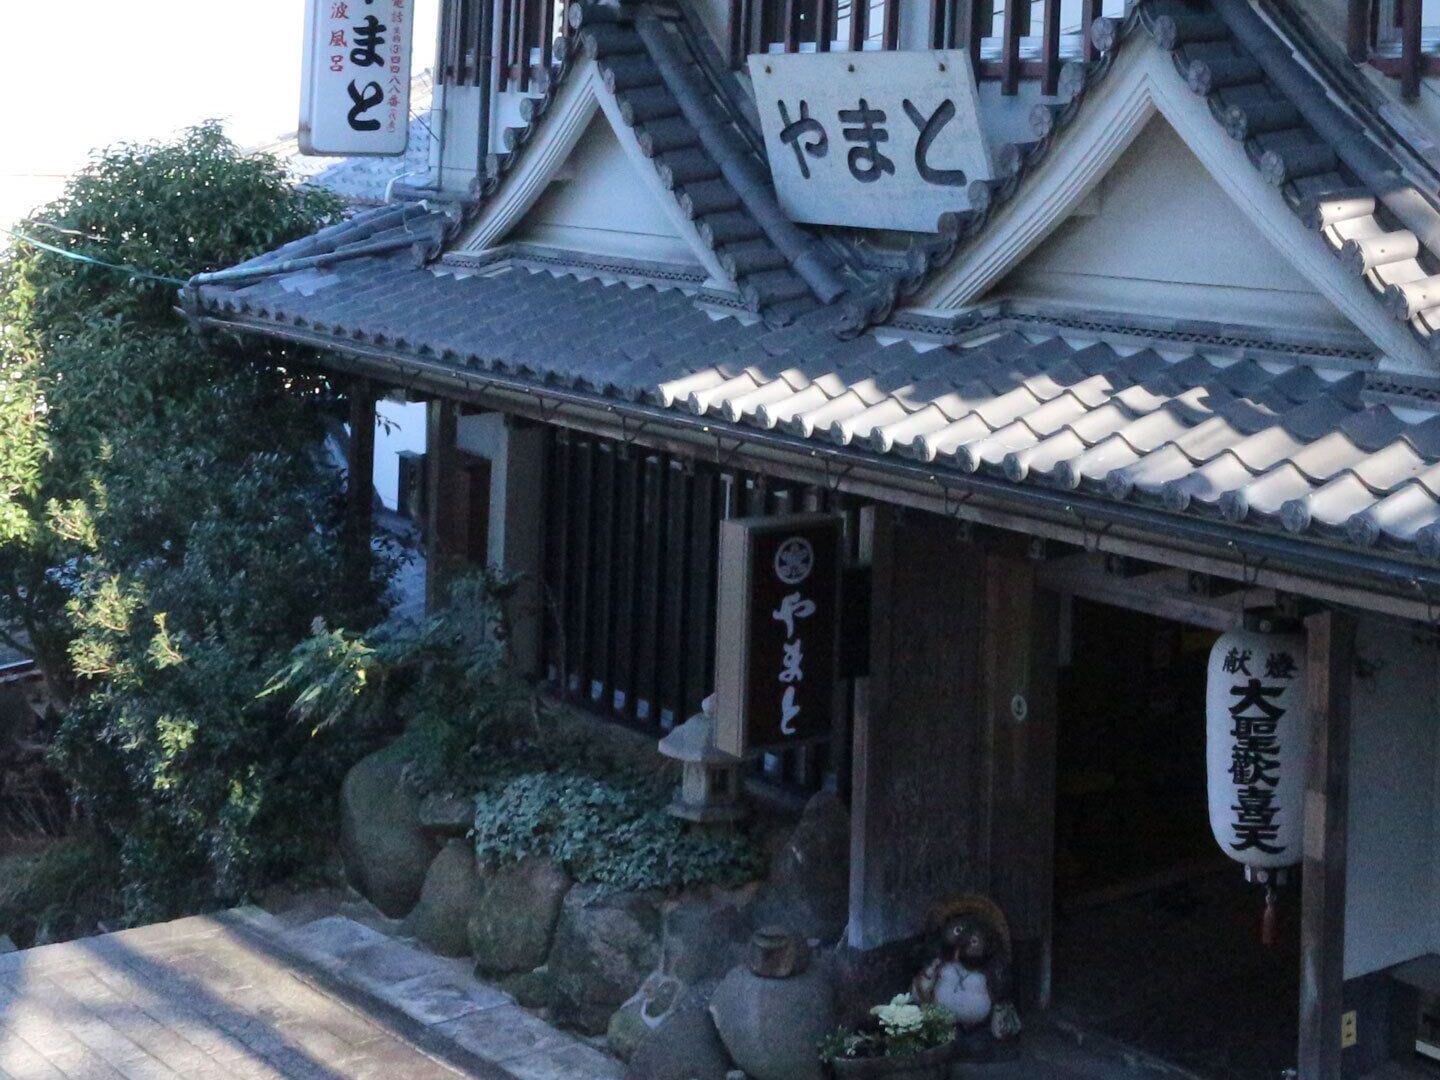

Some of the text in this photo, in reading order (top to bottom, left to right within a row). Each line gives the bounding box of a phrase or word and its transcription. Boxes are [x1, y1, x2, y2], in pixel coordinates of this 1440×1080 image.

[777, 97, 968, 188] やまと
[772, 591, 817, 736] やまと
